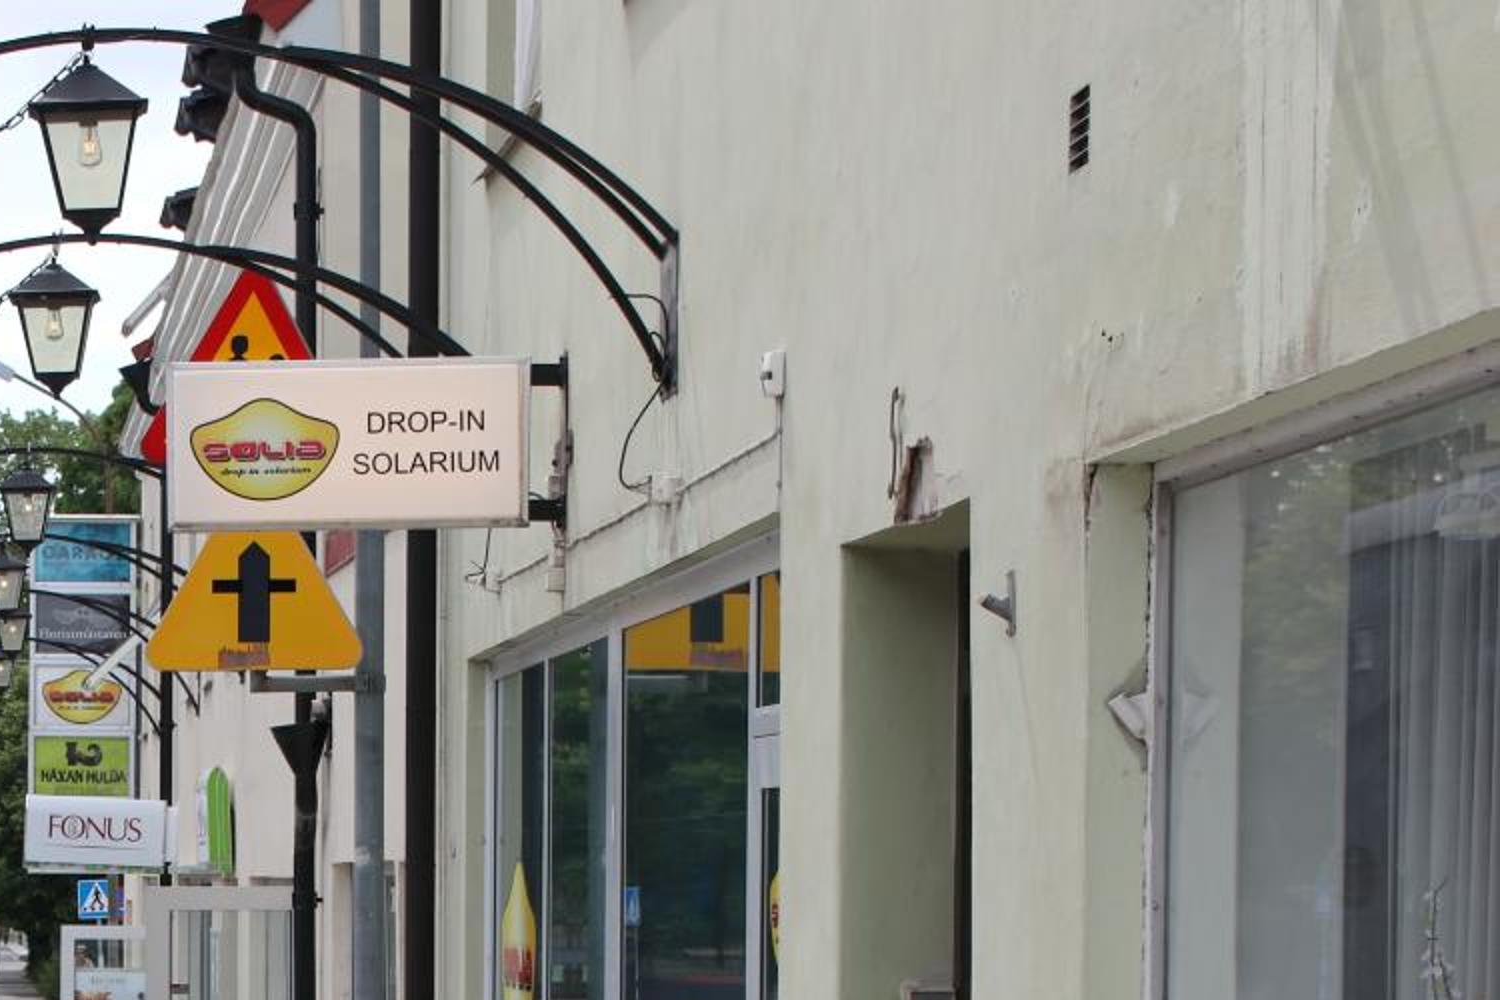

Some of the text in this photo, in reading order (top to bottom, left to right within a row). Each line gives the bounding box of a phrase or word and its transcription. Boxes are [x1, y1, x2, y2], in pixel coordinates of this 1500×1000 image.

[367, 409, 485, 434] DROP-IN
[353, 449, 500, 475] SOLARIUM
[48, 814, 142, 842] FONUS
